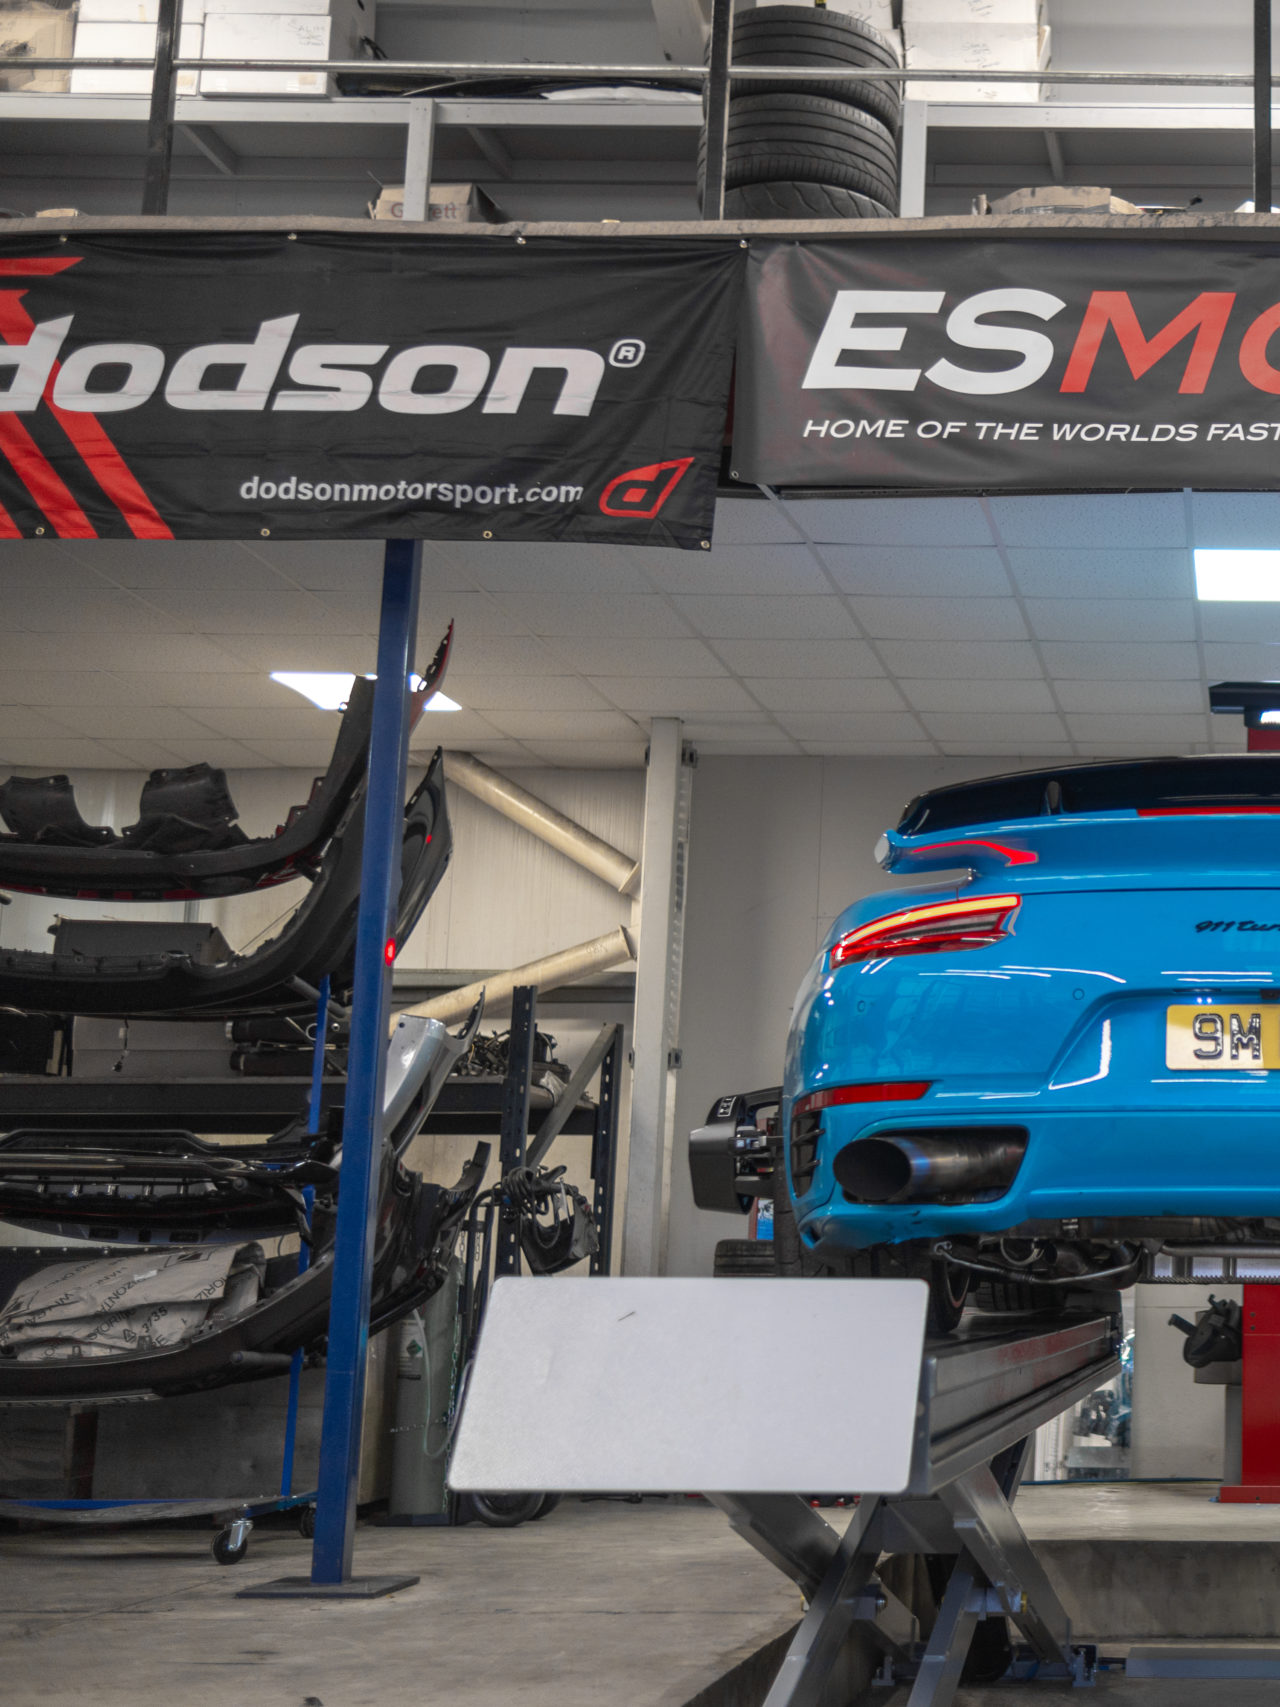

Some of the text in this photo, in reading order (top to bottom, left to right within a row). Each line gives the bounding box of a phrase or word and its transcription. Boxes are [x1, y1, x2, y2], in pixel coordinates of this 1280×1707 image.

[390, 201, 457, 219] Gett
[802, 419, 909, 439] HOME
[916, 420, 968, 440] OF
[975, 422, 1043, 441] THE
[1051, 422, 1198, 442] WORLDS
[240, 475, 584, 507] dodsonmotorsport.com
[1193, 1013, 1262, 1061] 9M
